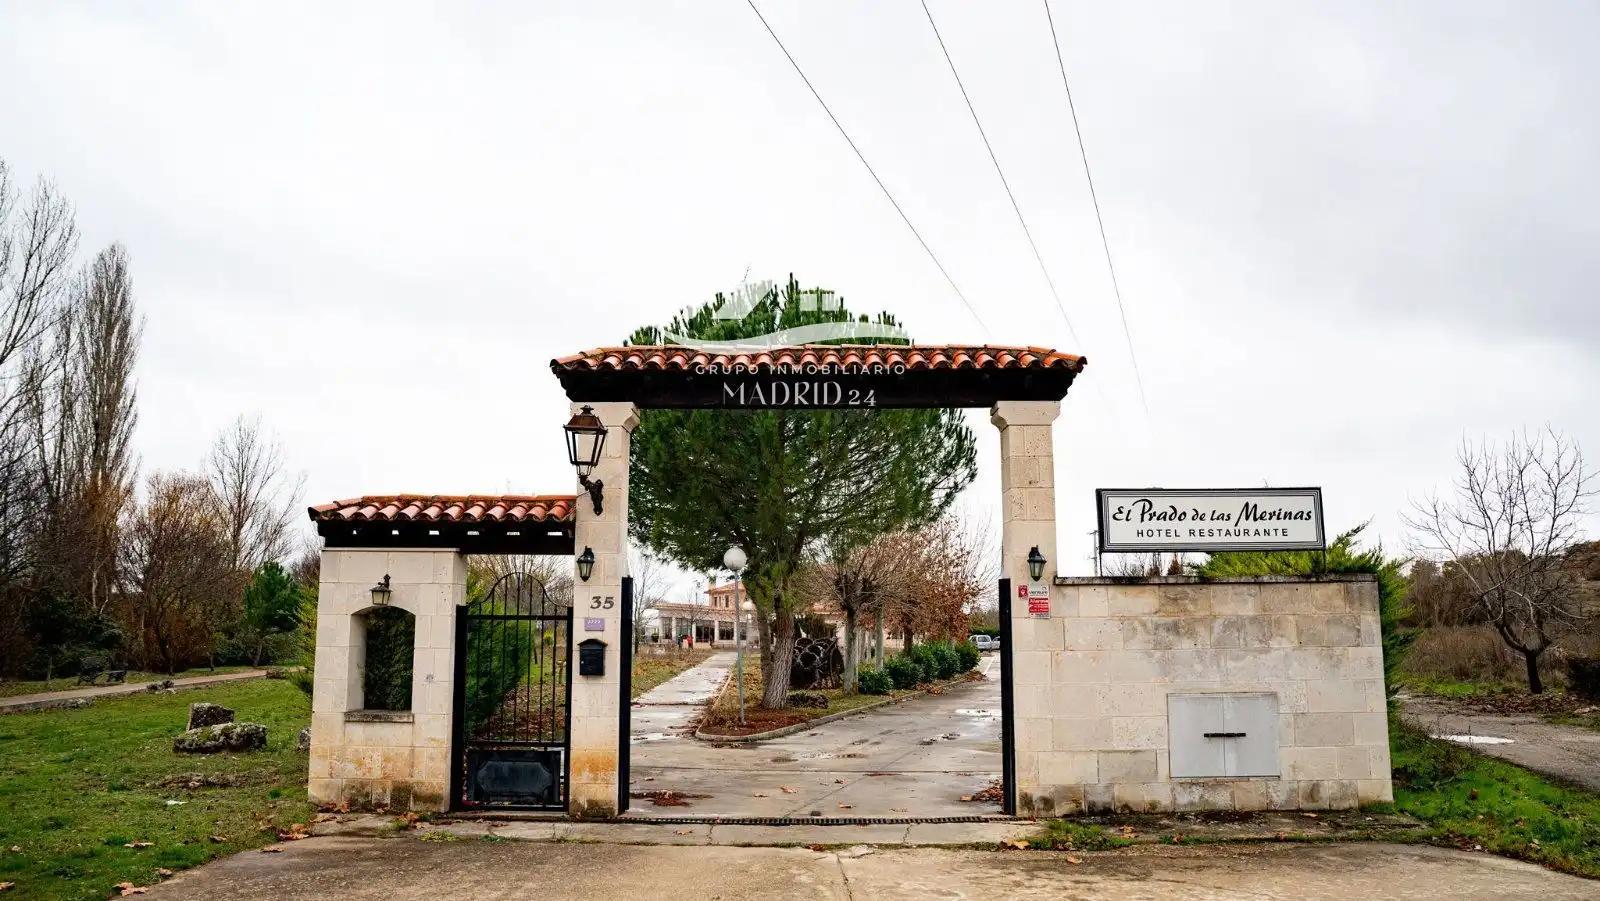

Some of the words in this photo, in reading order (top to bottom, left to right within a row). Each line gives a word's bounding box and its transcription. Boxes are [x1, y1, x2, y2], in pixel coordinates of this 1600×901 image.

[1112, 505, 1132, 522] El
[1132, 498, 1187, 523] Prado
[1191, 508, 1206, 522] de
[1234, 501, 1313, 527] Merinas
[1136, 529, 1181, 538] HOTEL
[1189, 528, 1289, 538] RESTAURANTE
[590, 596, 615, 609] 35
